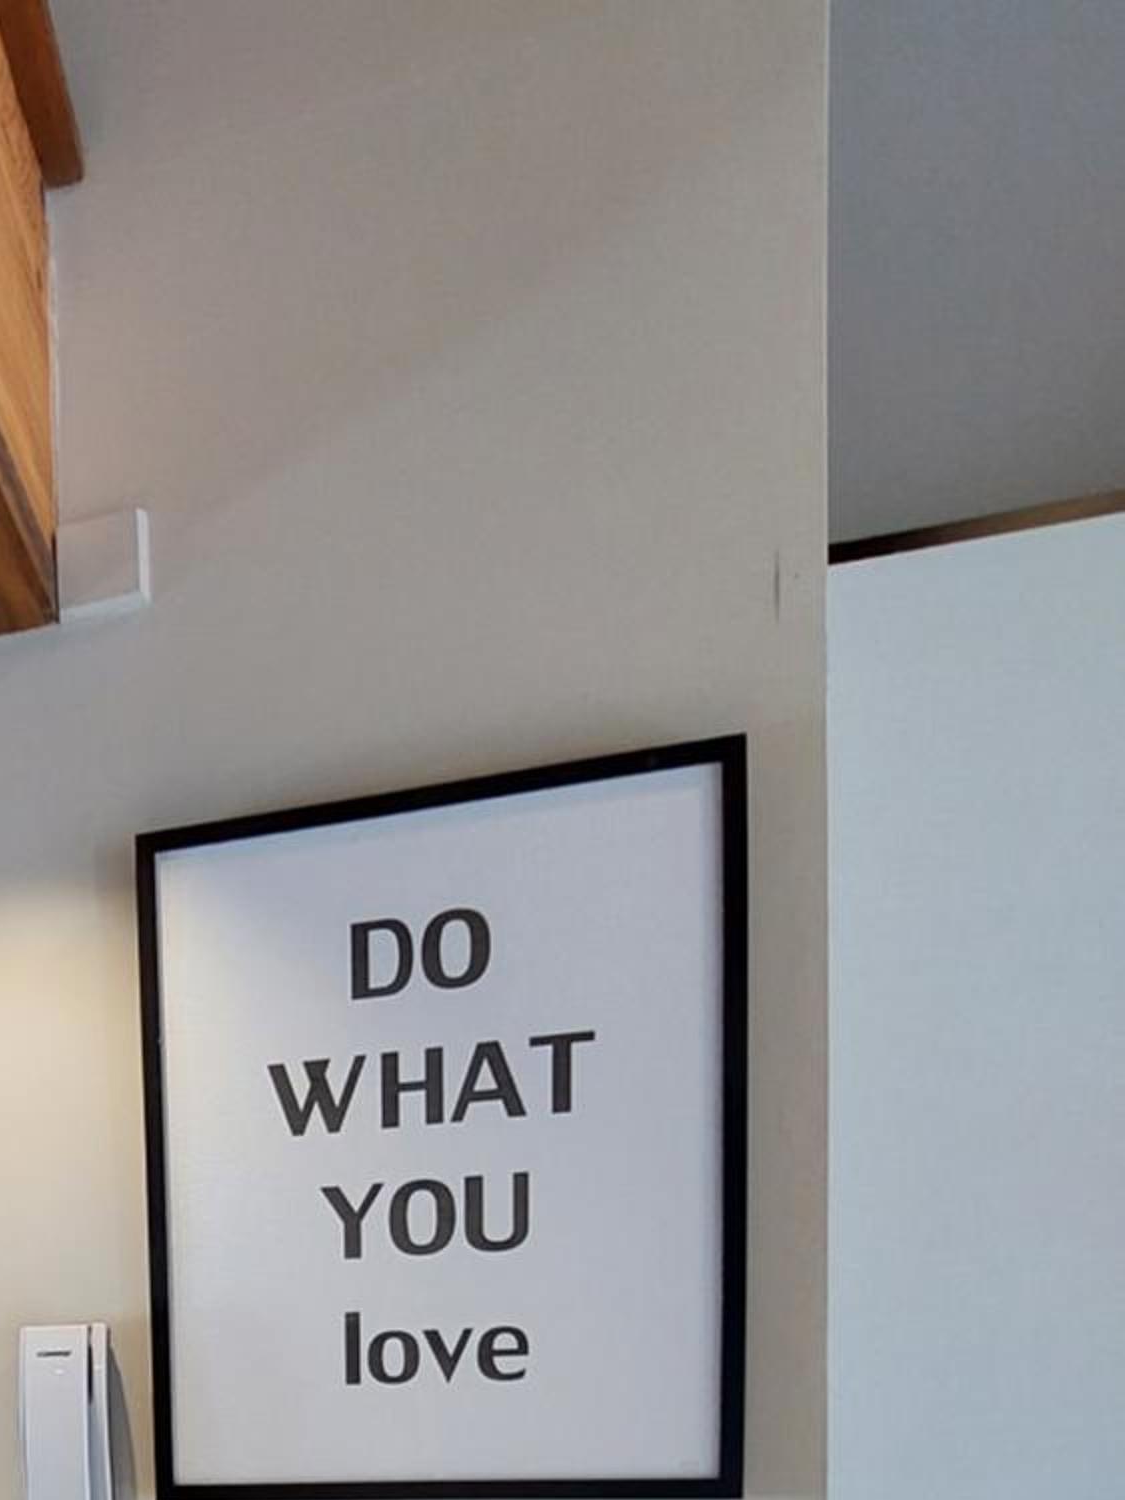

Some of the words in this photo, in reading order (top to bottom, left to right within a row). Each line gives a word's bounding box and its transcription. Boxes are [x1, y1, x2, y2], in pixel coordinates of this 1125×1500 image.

[350, 908, 491, 1000] DO
[268, 1031, 595, 1136] WHAT
[321, 1171, 530, 1259] YOU
[344, 1311, 529, 1385] love
